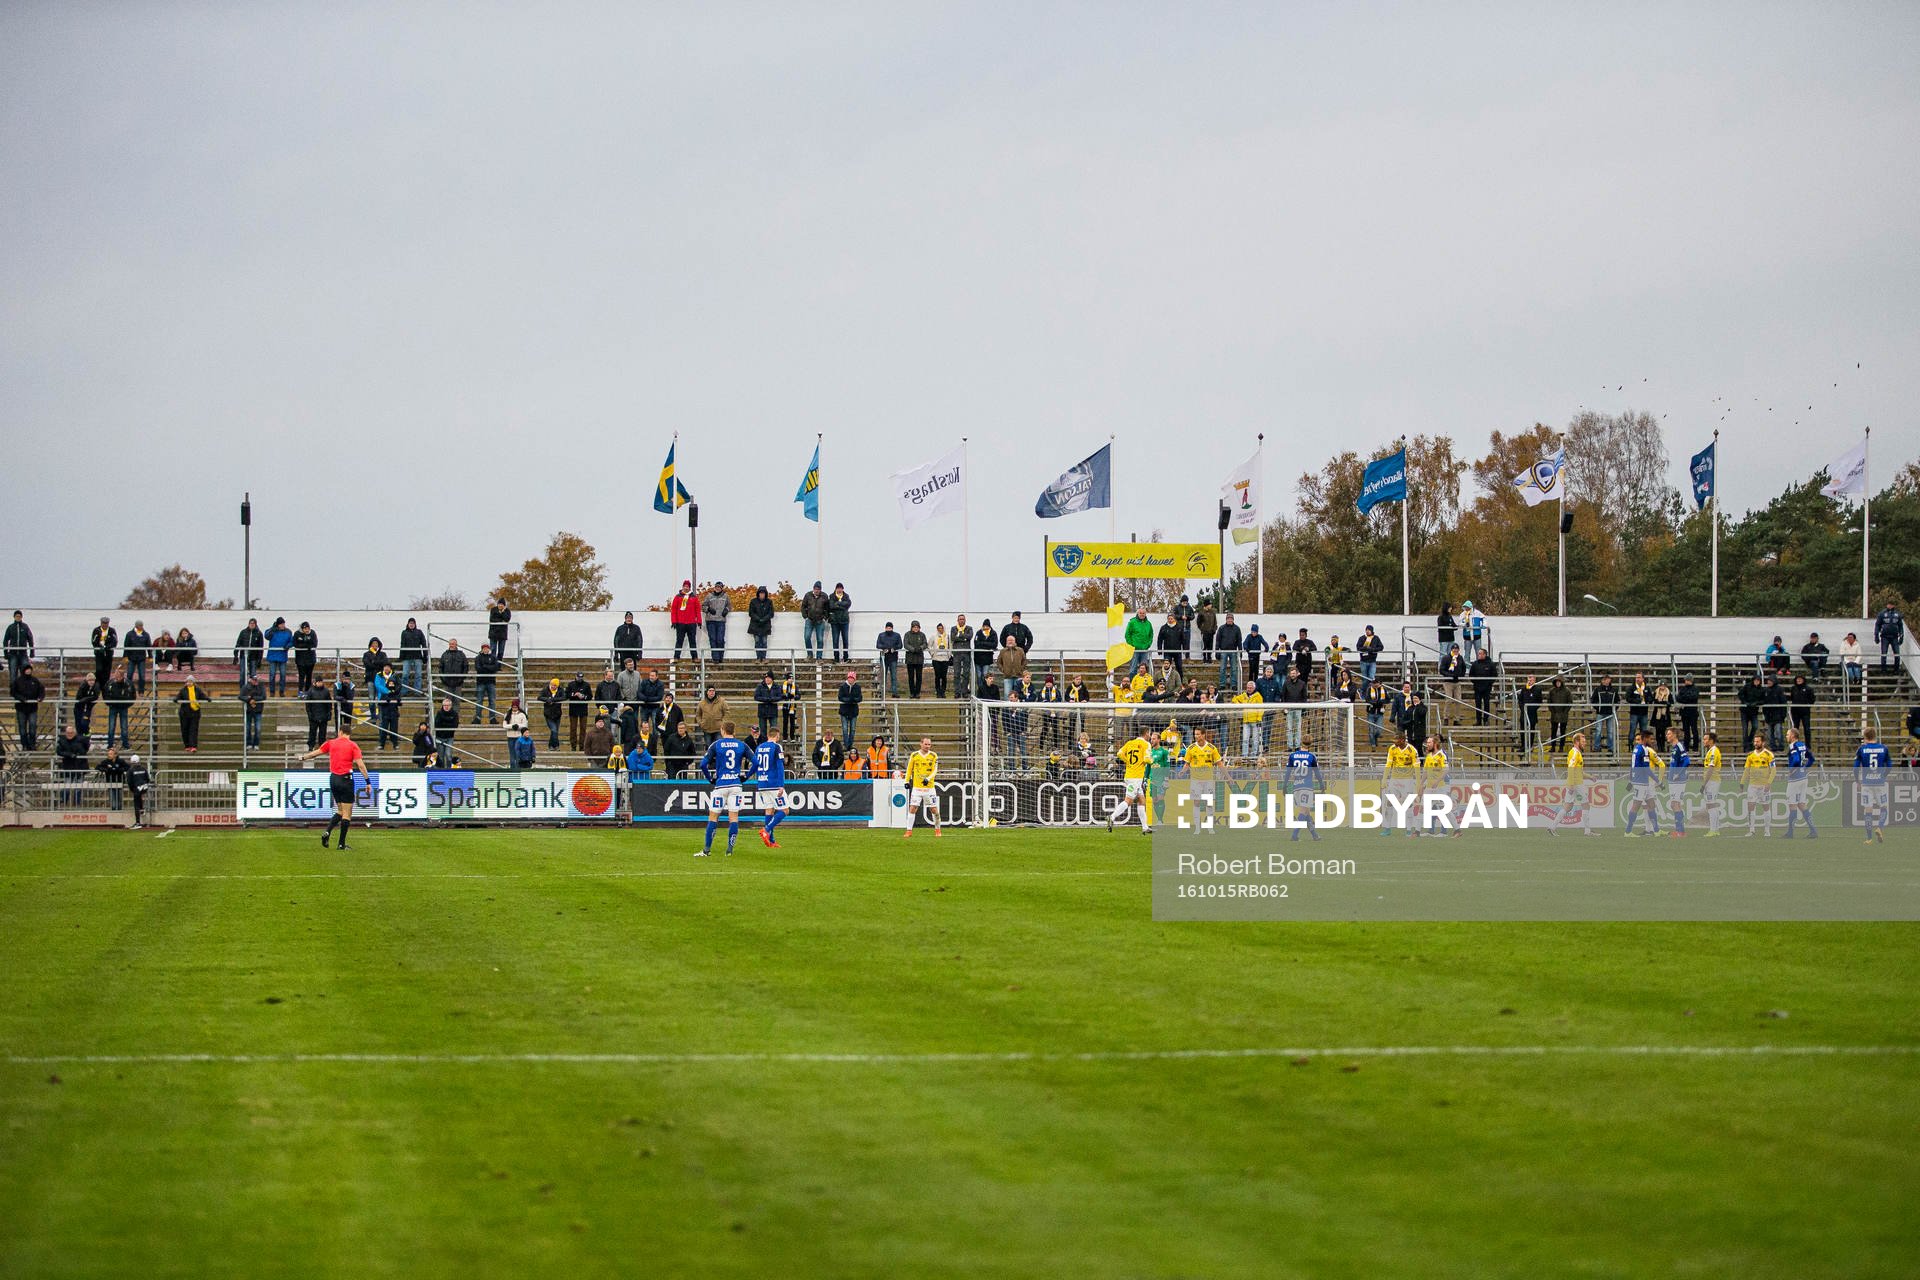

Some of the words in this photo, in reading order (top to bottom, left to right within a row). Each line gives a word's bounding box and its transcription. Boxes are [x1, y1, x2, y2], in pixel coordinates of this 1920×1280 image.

[1091, 554, 1123, 570] Laget
[1126, 555, 1143, 566] vid
[1145, 554, 1176, 566] havet
[725, 749, 736, 769] 3
[757, 753, 769, 771] 20
[1128, 750, 1139, 764] 15
[1869, 753, 1878, 770] 5
[1293, 759, 1309, 777] 26
[243, 780, 418, 815] Falkenergs
[429, 781, 565, 814] Sparbank
[683, 790, 843, 810] ENELONS
